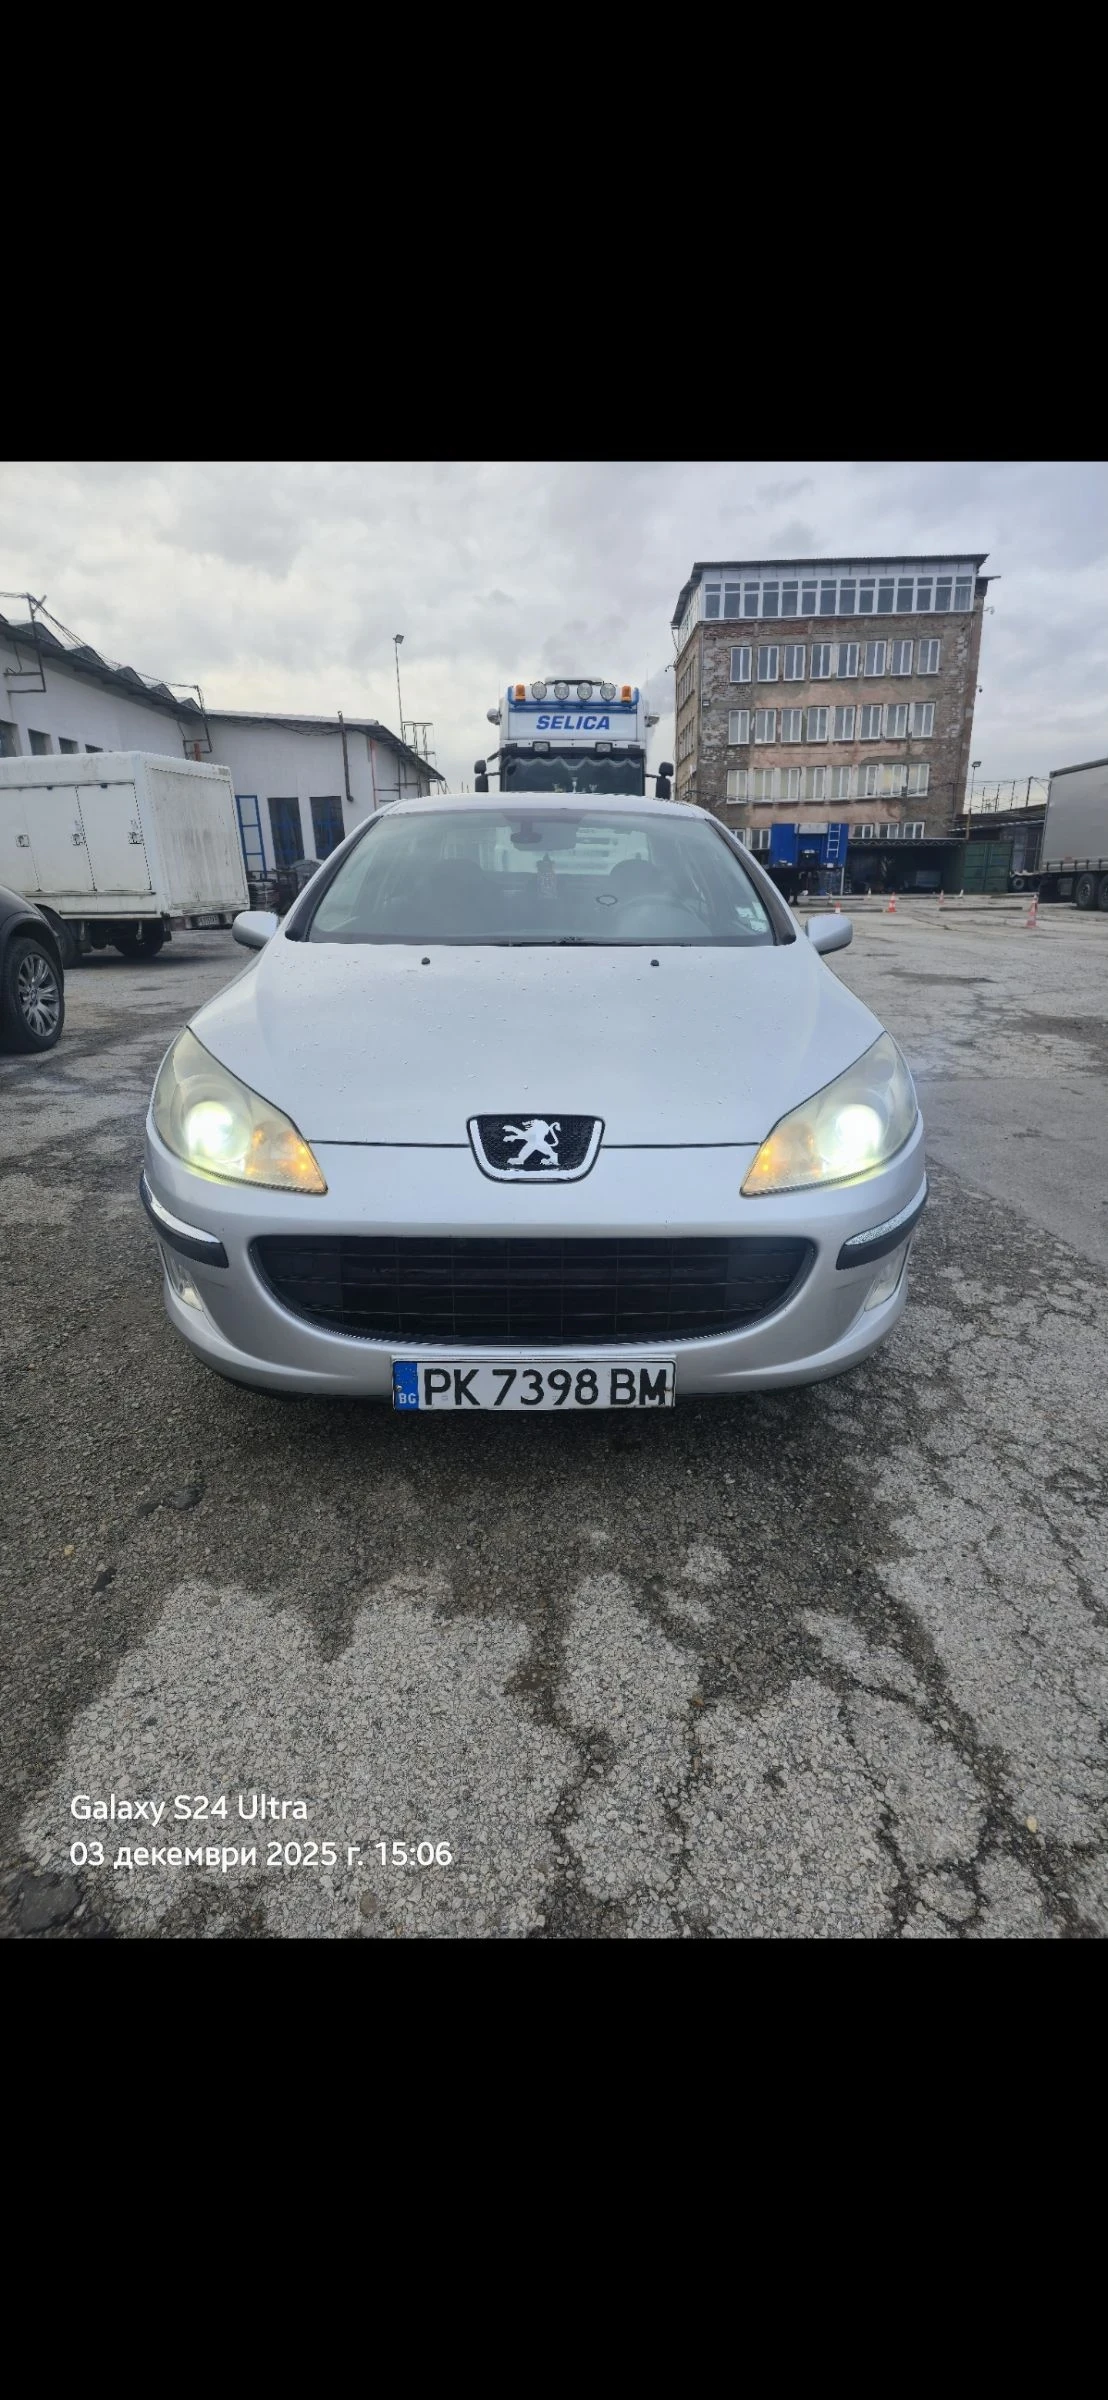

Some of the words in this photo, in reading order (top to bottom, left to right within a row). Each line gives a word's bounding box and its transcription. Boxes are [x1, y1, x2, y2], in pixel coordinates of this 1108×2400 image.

[536, 715, 611, 731] SELICA
[424, 1368, 481, 1406] PK
[491, 1368, 599, 1406] 7398
[609, 1368, 668, 1406] BM
[398, 1392, 417, 1404] BG
